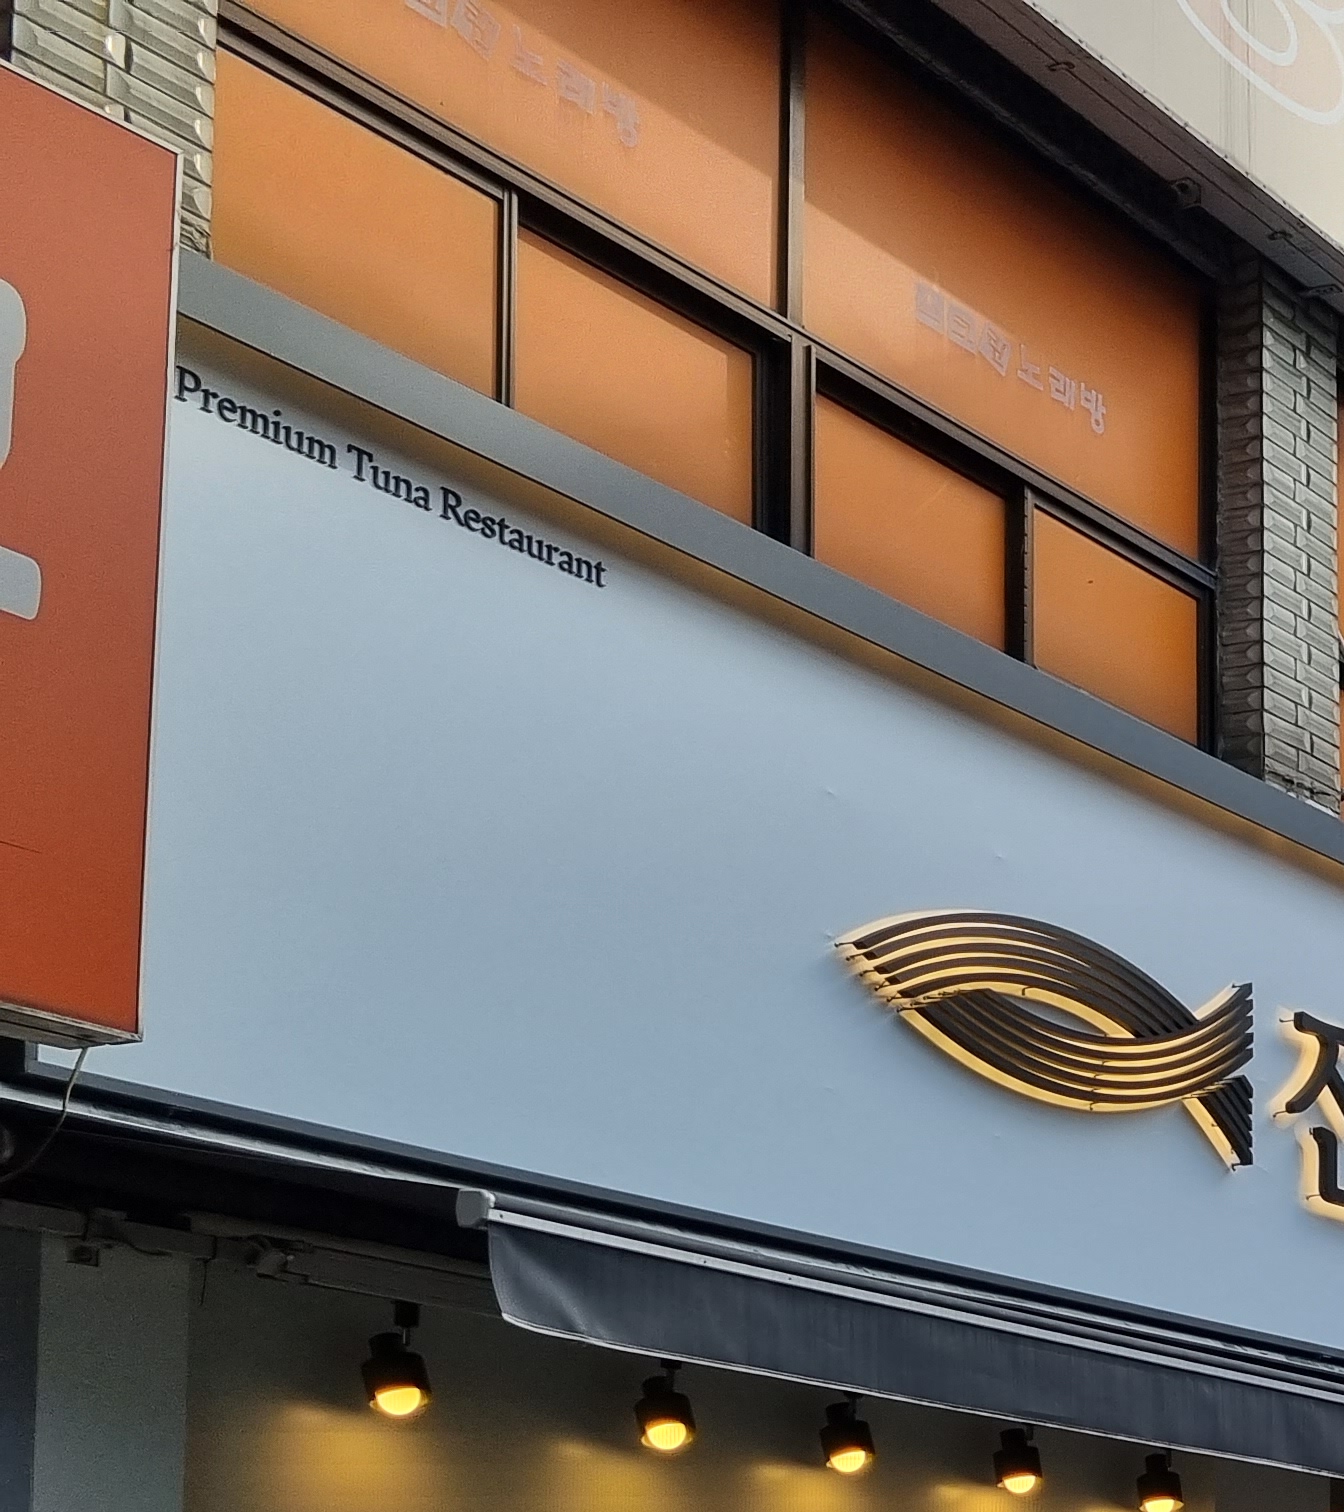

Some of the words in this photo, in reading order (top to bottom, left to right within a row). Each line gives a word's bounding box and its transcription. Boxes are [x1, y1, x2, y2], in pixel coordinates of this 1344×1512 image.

[174, 365, 338, 470] Premium
[347, 444, 432, 513] Tuna
[438, 486, 608, 589] Restaurant
